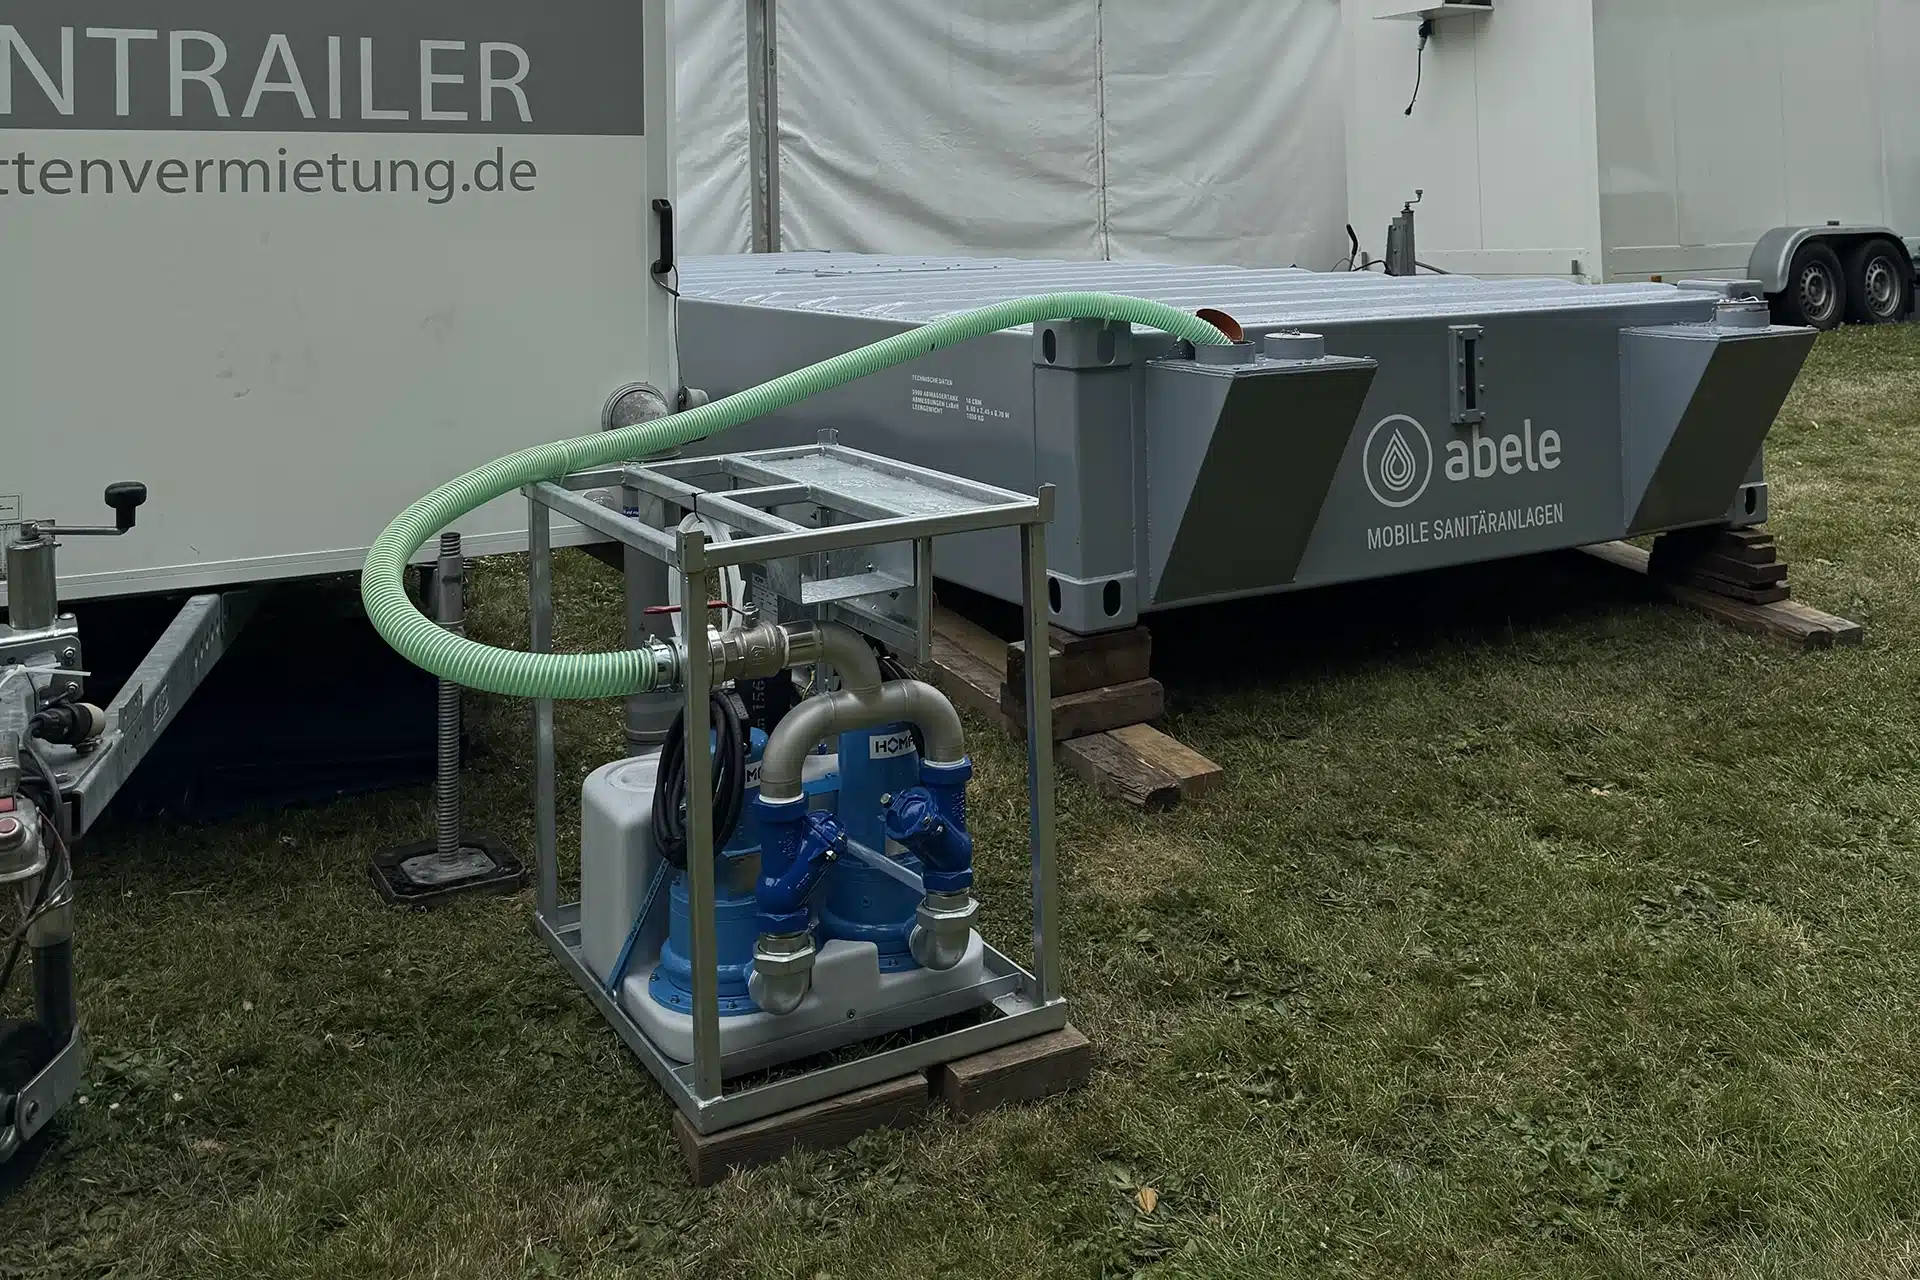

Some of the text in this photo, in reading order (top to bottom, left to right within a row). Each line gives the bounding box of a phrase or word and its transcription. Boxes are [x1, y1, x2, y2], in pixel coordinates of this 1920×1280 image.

[0, 24, 533, 122] NTRAILER
[1444, 418, 1562, 482] abele
[1367, 502, 1564, 550] MOBILE SANITÄRANLAGEN
